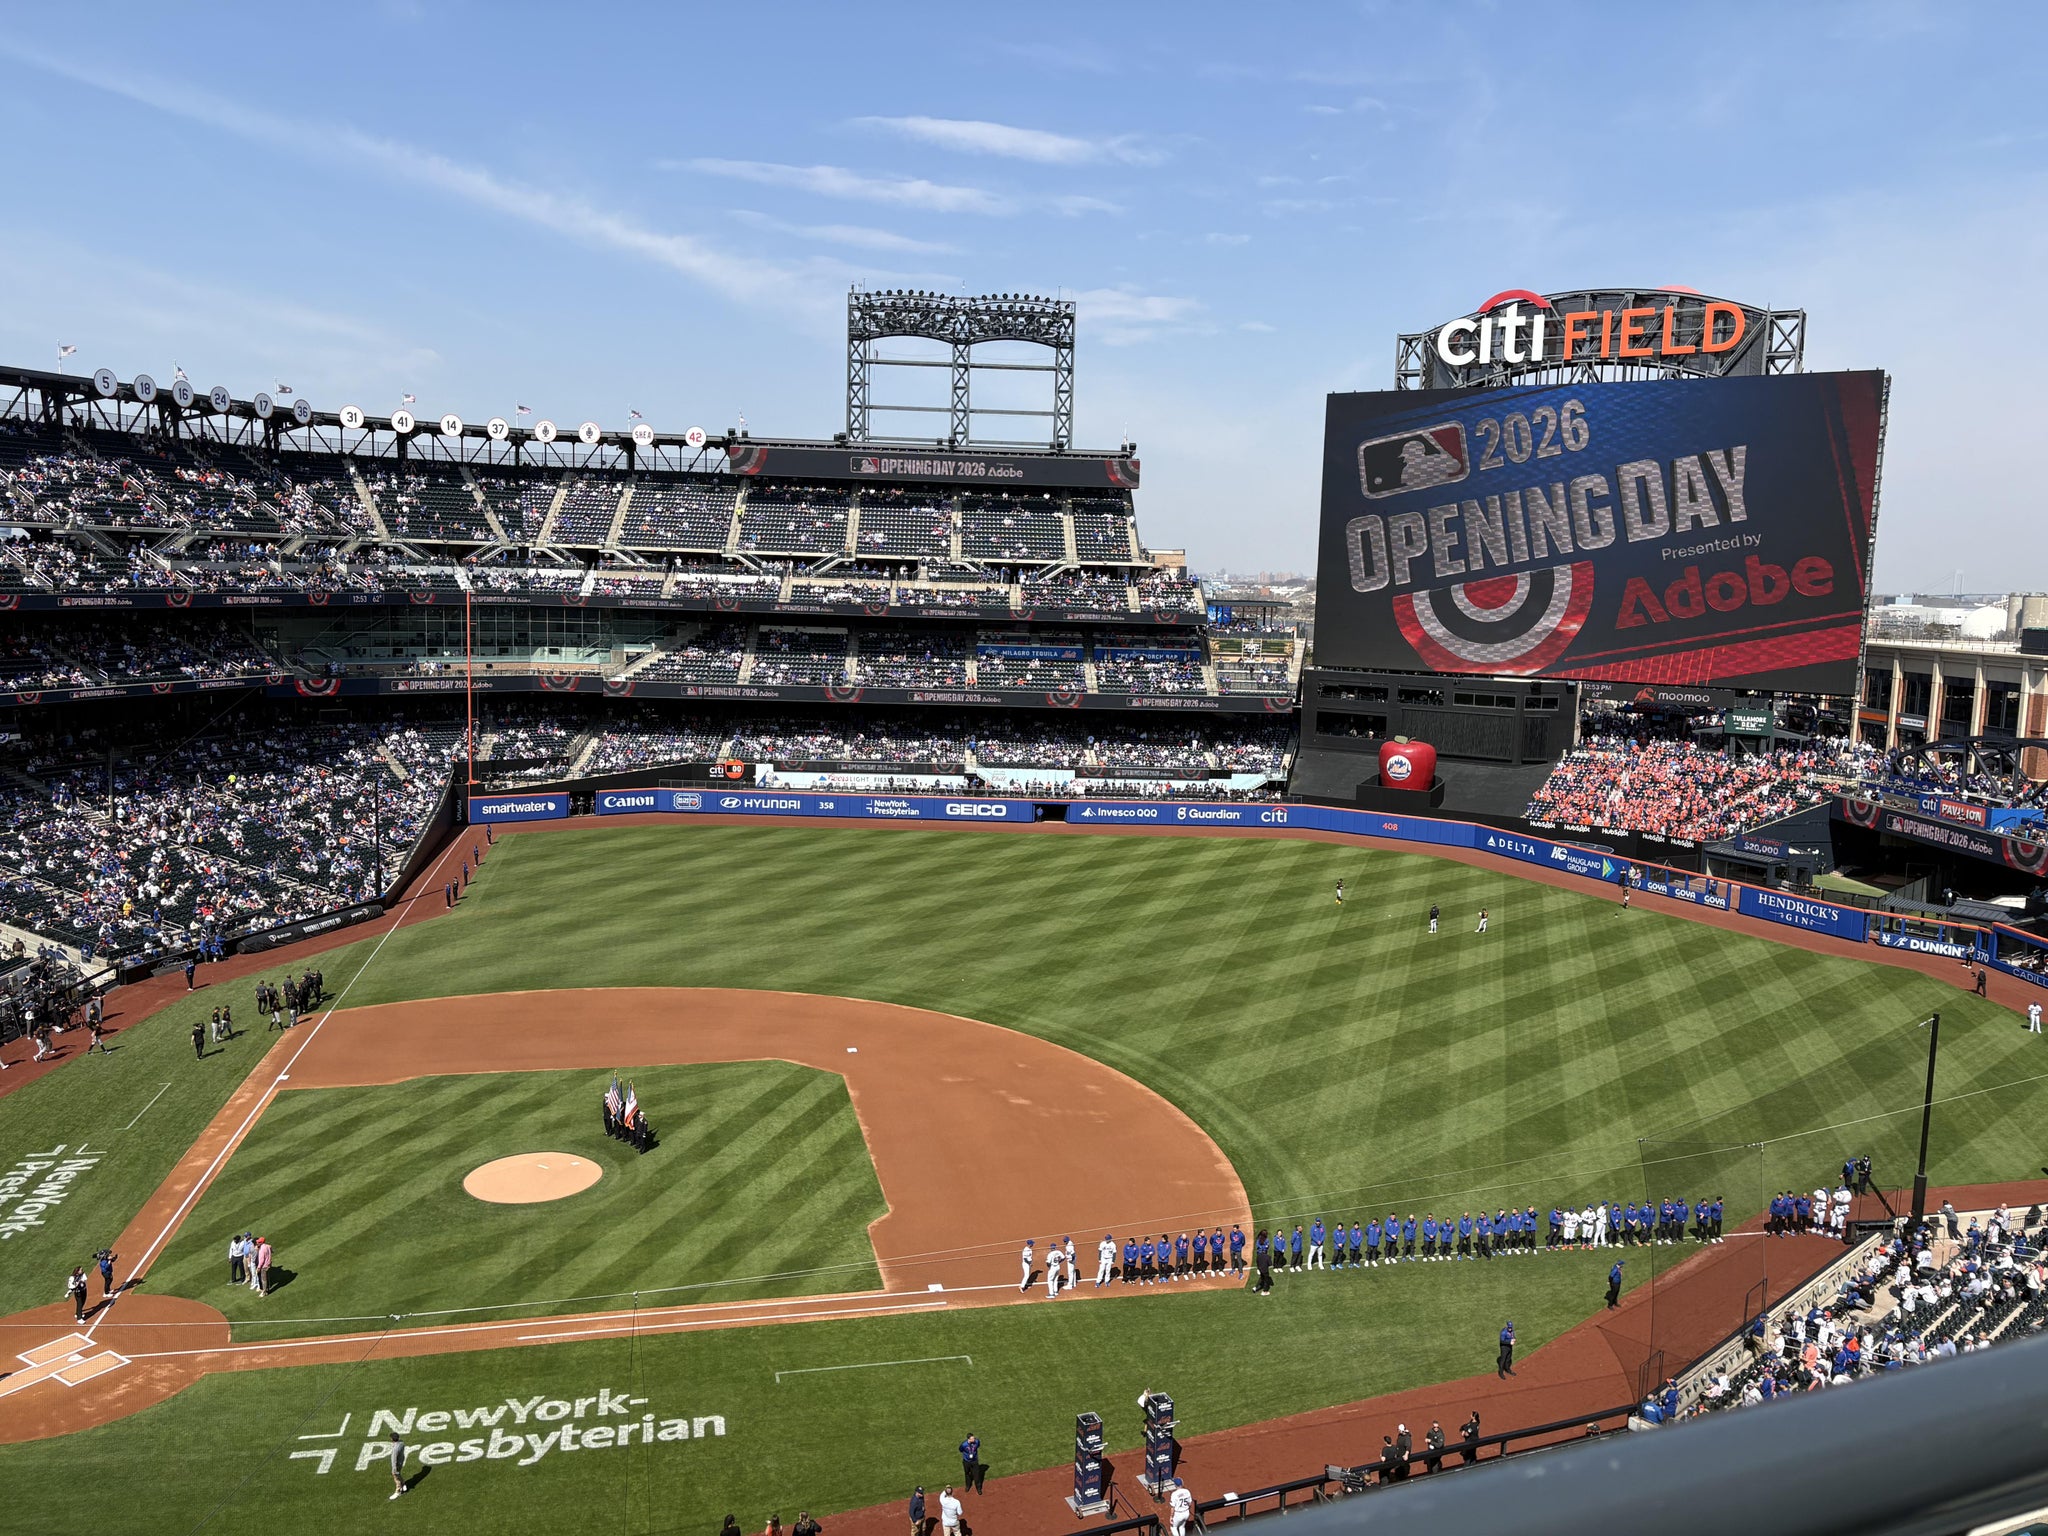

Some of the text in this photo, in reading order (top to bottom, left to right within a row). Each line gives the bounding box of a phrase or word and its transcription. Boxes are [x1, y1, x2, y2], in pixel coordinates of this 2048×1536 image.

[1438, 302, 1746, 365] citi FIELD
[102, 377, 110, 389] 5
[140, 382, 151, 395] 18
[178, 387, 188, 401] 16
[214, 393, 226, 407] 24
[259, 400, 268, 412] 17
[297, 406, 308, 418] 36
[346, 412, 357, 423] 31
[397, 416, 408, 428] 41
[446, 420, 457, 431] 14
[492, 424, 504, 434] 37
[689, 432, 702, 443] 42
[1475, 399, 1590, 471] 2026
[881, 458, 1023, 478] OPENING DAY 2026 Adobe
[1346, 444, 1748, 592] OPENING DAY
[1661, 532, 1762, 561] Presented by
[1615, 554, 1835, 631] Adobe
[454, 680, 469, 689] 202
[1584, 683, 1612, 692] 12:53 PM
[742, 688, 758, 697] 2026
[965, 694, 981, 703] 2026
[1658, 691, 1710, 703] moomoo
[1182, 699, 1199, 708] 2026
[709, 766, 724, 774] citi
[482, 801, 546, 815] smartwater
[603, 796, 654, 808] Canon
[744, 798, 800, 810] HYUNDAI
[819, 802, 835, 810] 358
[874, 799, 910, 808] NewYork-
[1922, 798, 1937, 811] citi
[874, 807, 919, 816] Presbyterian
[946, 803, 1007, 817] GEICO
[1098, 807, 1158, 818] Invesco QQQ
[1188, 808, 1240, 820] Guardian
[1261, 810, 1287, 823] citi
[1382, 823, 1398, 831] 408
[1904, 819, 1994, 855] OPENING DAY 2026 Adobe
[1499, 838, 1535, 856] DELTA
[1744, 842, 1779, 855] $20,000
[1567, 856, 1601, 870] HAUGLAND
[1567, 863, 1588, 874] GROUP
[1647, 882, 1668, 892] GOYA
[1675, 888, 1696, 899] GOYA
[1704, 894, 1726, 907] GOYA
[1758, 893, 1839, 921] HENDRICK'S
[1785, 913, 1809, 925] GIN
[1910, 939, 1965, 958] DUNKIN'
[1976, 950, 1990, 963] 370
[366, 1388, 649, 1437] NewYork-
[354, 1413, 726, 1472] Presbyterian
